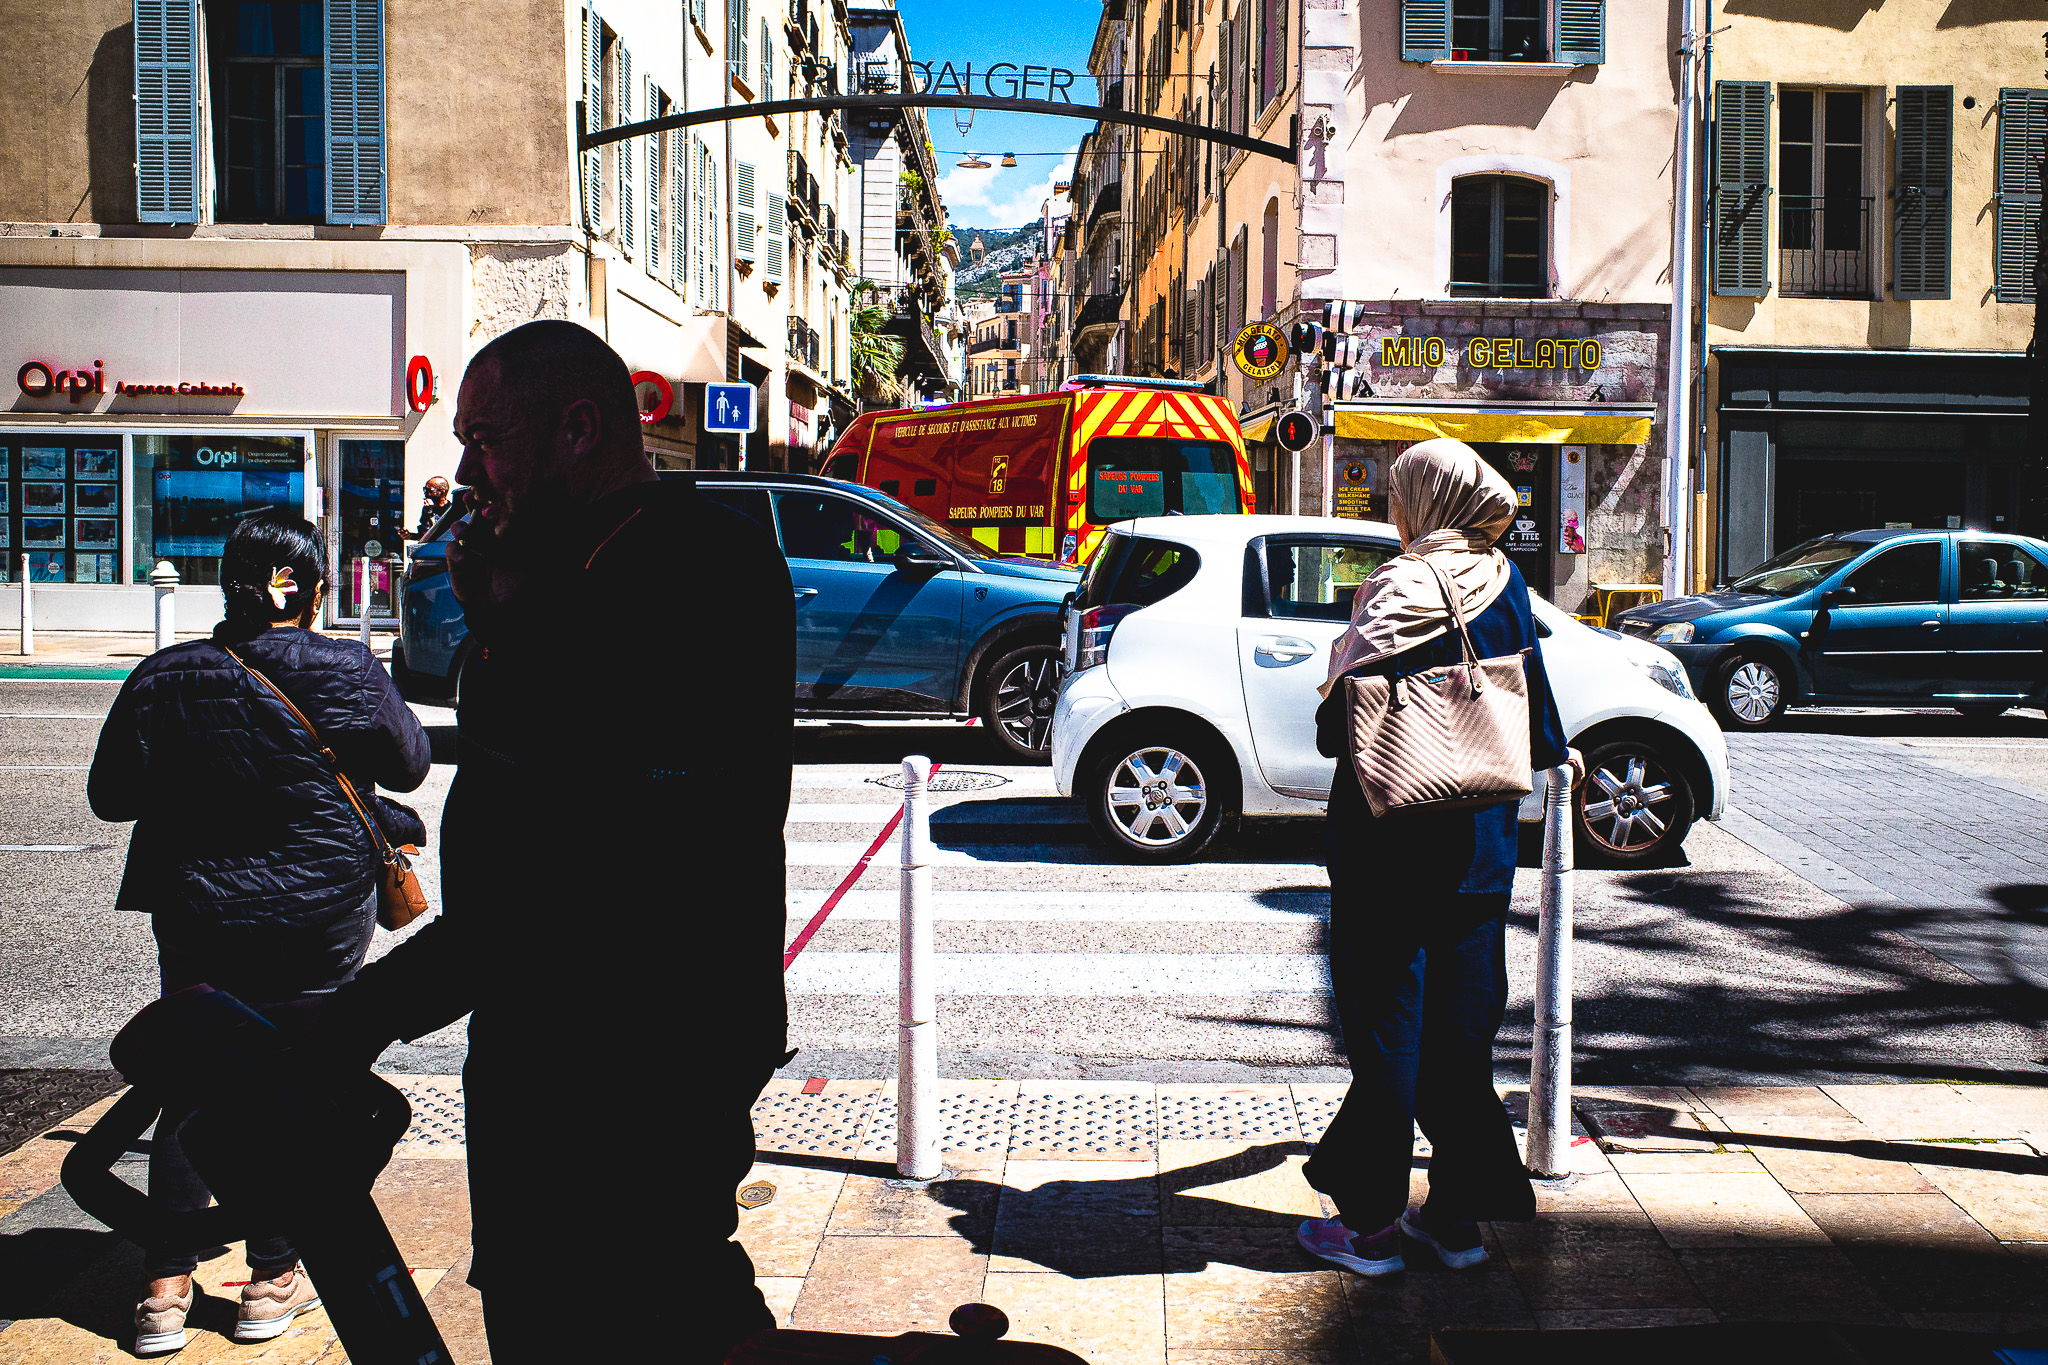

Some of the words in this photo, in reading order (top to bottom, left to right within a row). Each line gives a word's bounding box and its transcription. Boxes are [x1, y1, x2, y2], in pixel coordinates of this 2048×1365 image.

[1236, 331, 1250, 347] MIO
[1250, 325, 1282, 342] GELATO
[1381, 336, 1446, 368] MIO
[1468, 336, 1602, 370] GELATO
[1242, 360, 1283, 376] GELATERIA
[16, 358, 105, 404] Orpi
[114, 380, 176, 398] Agence
[177, 381, 246, 397] Cabanis
[918, 426, 927, 436] DE
[927, 423, 950, 435] SECOURS
[951, 421, 960, 433] ET
[960, 417, 997, 432] D'ASSISTANCE
[997, 416, 1009, 428] AUX
[1011, 414, 1038, 428] VICTIMES
[196, 445, 237, 468] Orpi
[992, 479, 1003, 491] 18
[1098, 471, 1127, 481] SAPEURS
[1129, 472, 1160, 481] POMPIERS
[1117, 484, 1128, 493] DU
[1129, 484, 1144, 493] VAR
[948, 506, 978, 519] SAPEURS
[979, 505, 1013, 519] POMPIERS
[1015, 505, 1027, 518] DU
[1029, 505, 1045, 518] VAR
